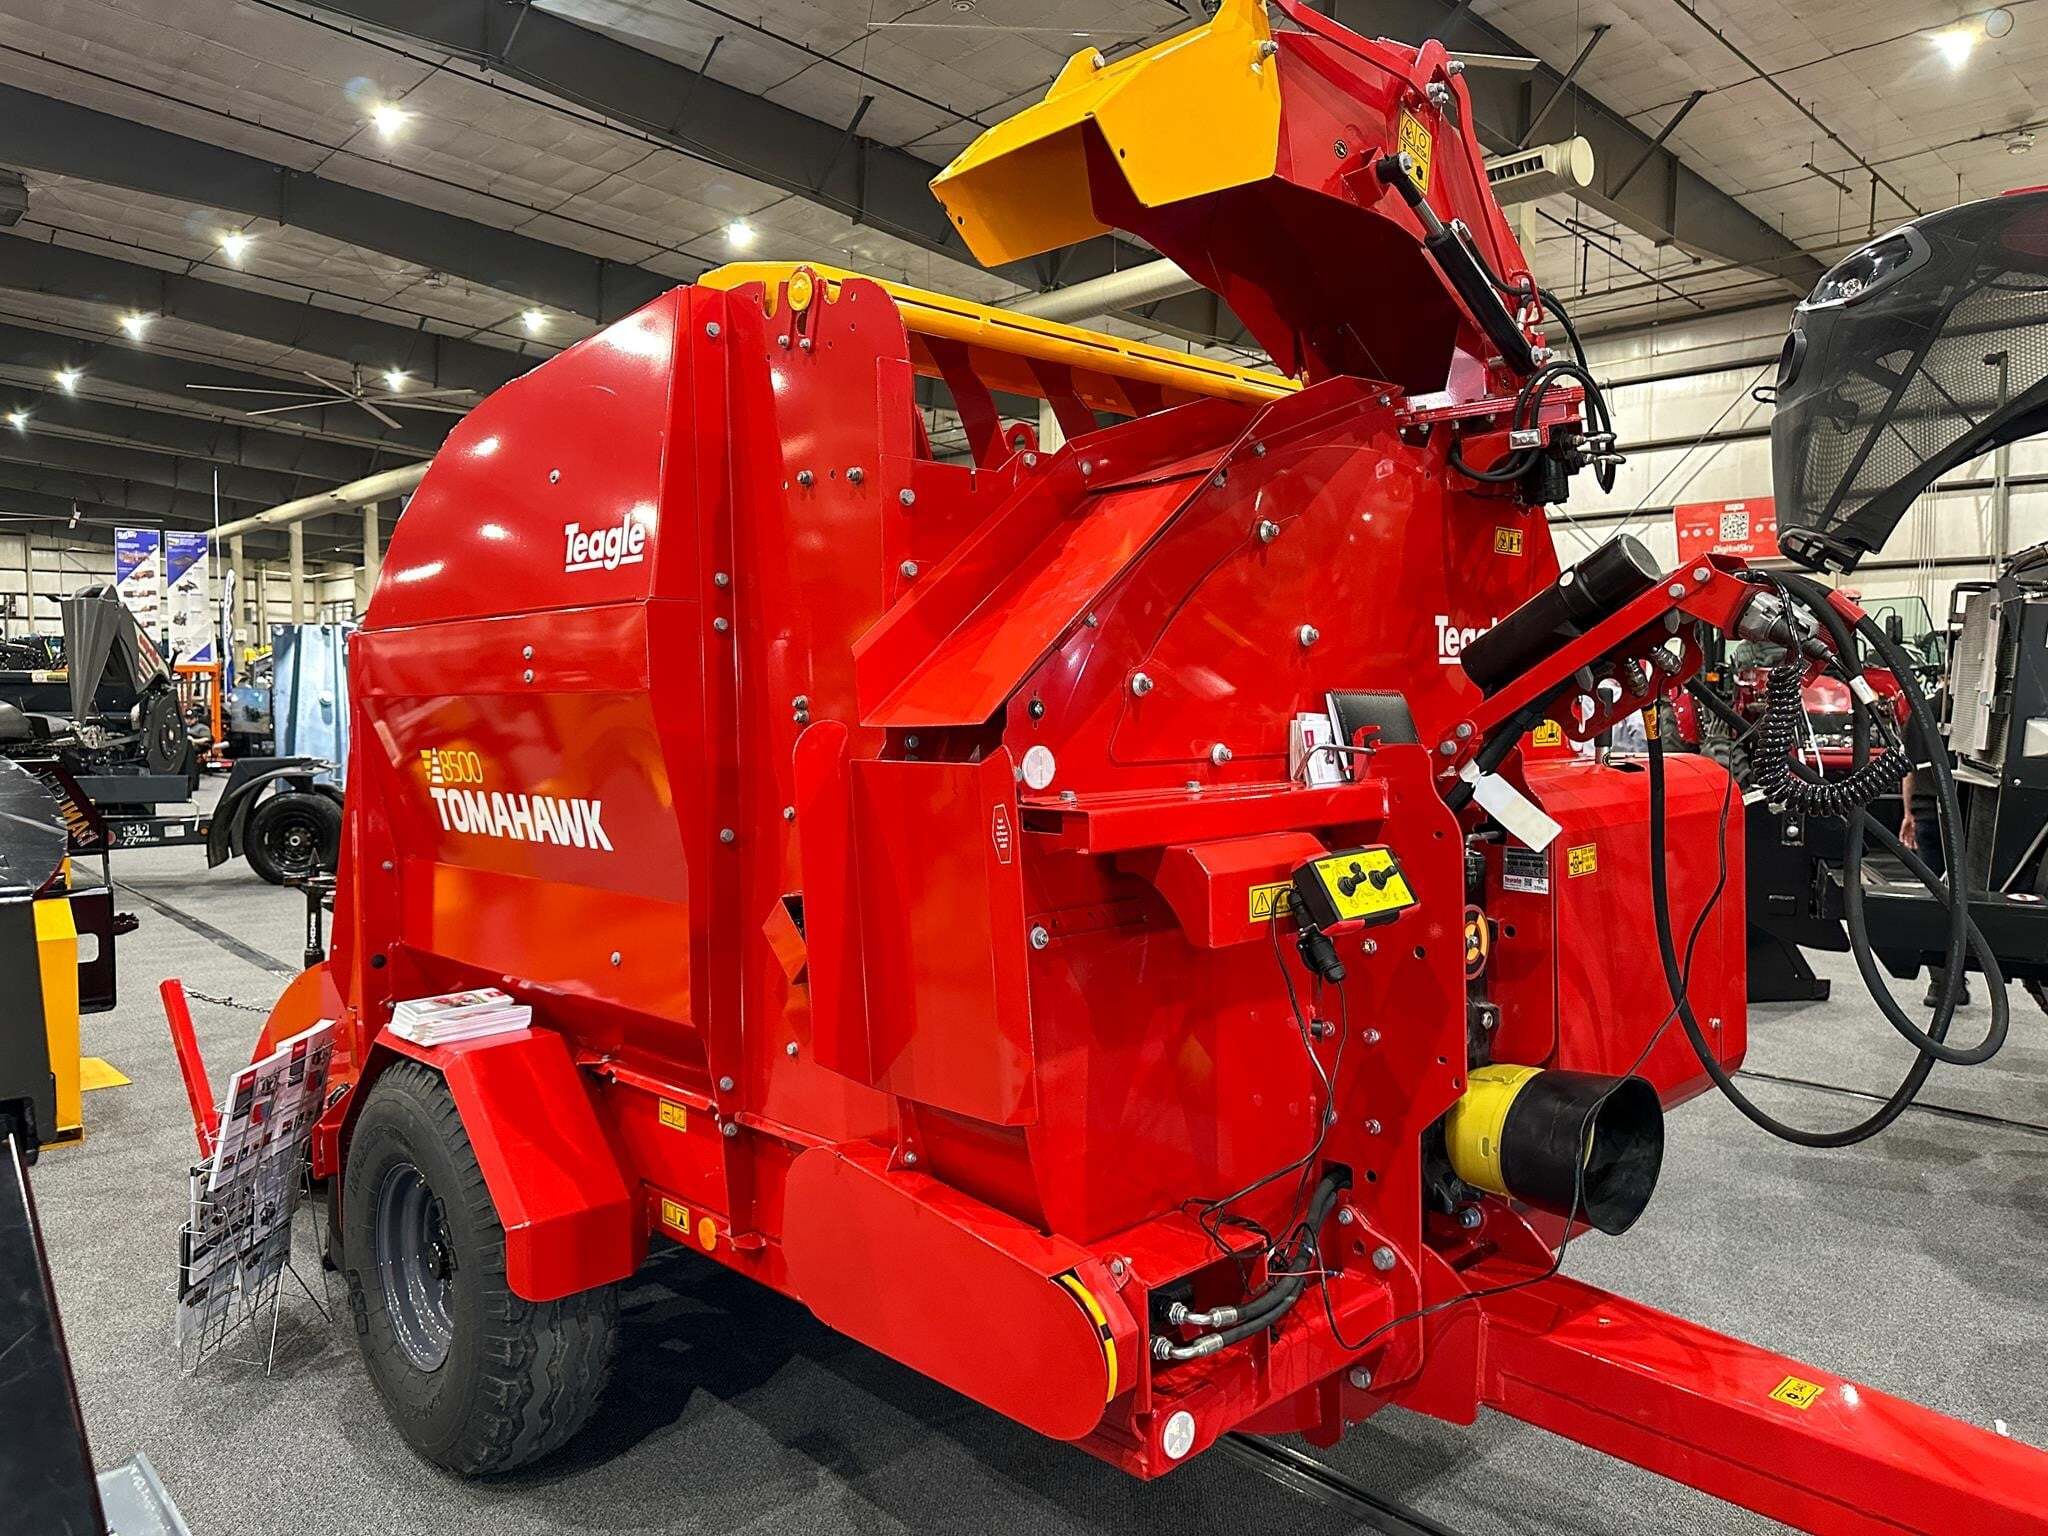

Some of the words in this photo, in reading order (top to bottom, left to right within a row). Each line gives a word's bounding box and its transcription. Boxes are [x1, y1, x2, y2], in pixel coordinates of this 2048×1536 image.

[565, 513, 646, 571] Teagle
[1712, 543, 1755, 554] DigitalSky
[1435, 615, 1498, 656] Tea
[438, 750, 483, 784] 8500
[429, 787, 614, 851] TOMAHAWK
